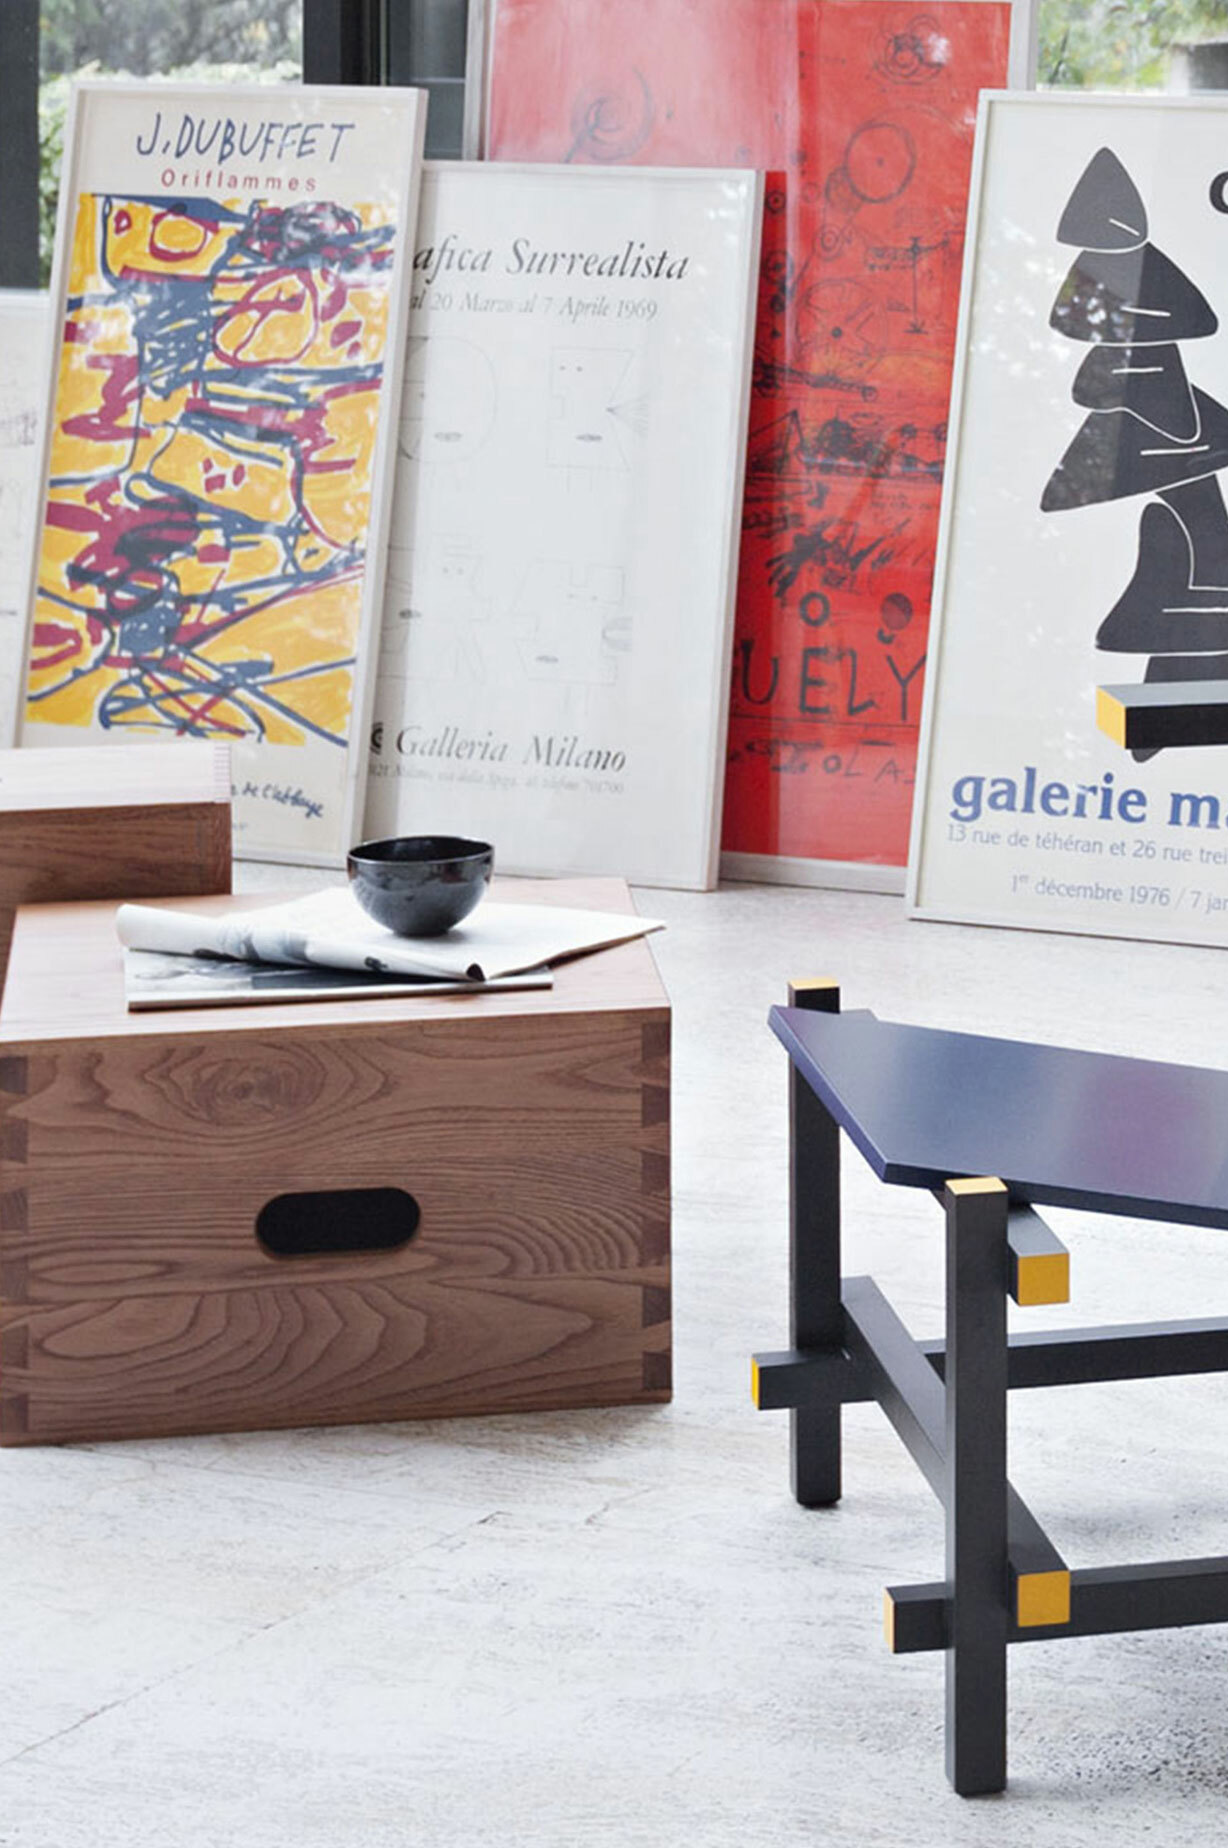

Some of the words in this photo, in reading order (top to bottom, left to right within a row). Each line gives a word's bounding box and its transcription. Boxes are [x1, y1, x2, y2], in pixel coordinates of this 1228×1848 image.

[160, 168, 317, 191] Oriflammes
[505, 237, 690, 281] Surrealista
[430, 293, 453, 311] 20
[517, 293, 538, 313] al
[543, 297, 554, 313] 7
[558, 296, 611, 323] Aprile
[616, 298, 659, 322] 1969
[396, 725, 509, 763] Galleria
[522, 735, 627, 772] Milano
[949, 766, 1148, 823] galerie
[947, 823, 967, 842] 13
[972, 829, 1001, 847] rue
[1007, 830, 1030, 849] de
[1035, 831, 1103, 855] téhéran
[1109, 839, 1127, 857] et
[1132, 838, 1157, 860] 26
[1162, 846, 1193, 863] rue
[1035, 876, 1124, 902] décembre
[1129, 885, 1171, 906] 1976
[1190, 890, 1202, 909] 7
